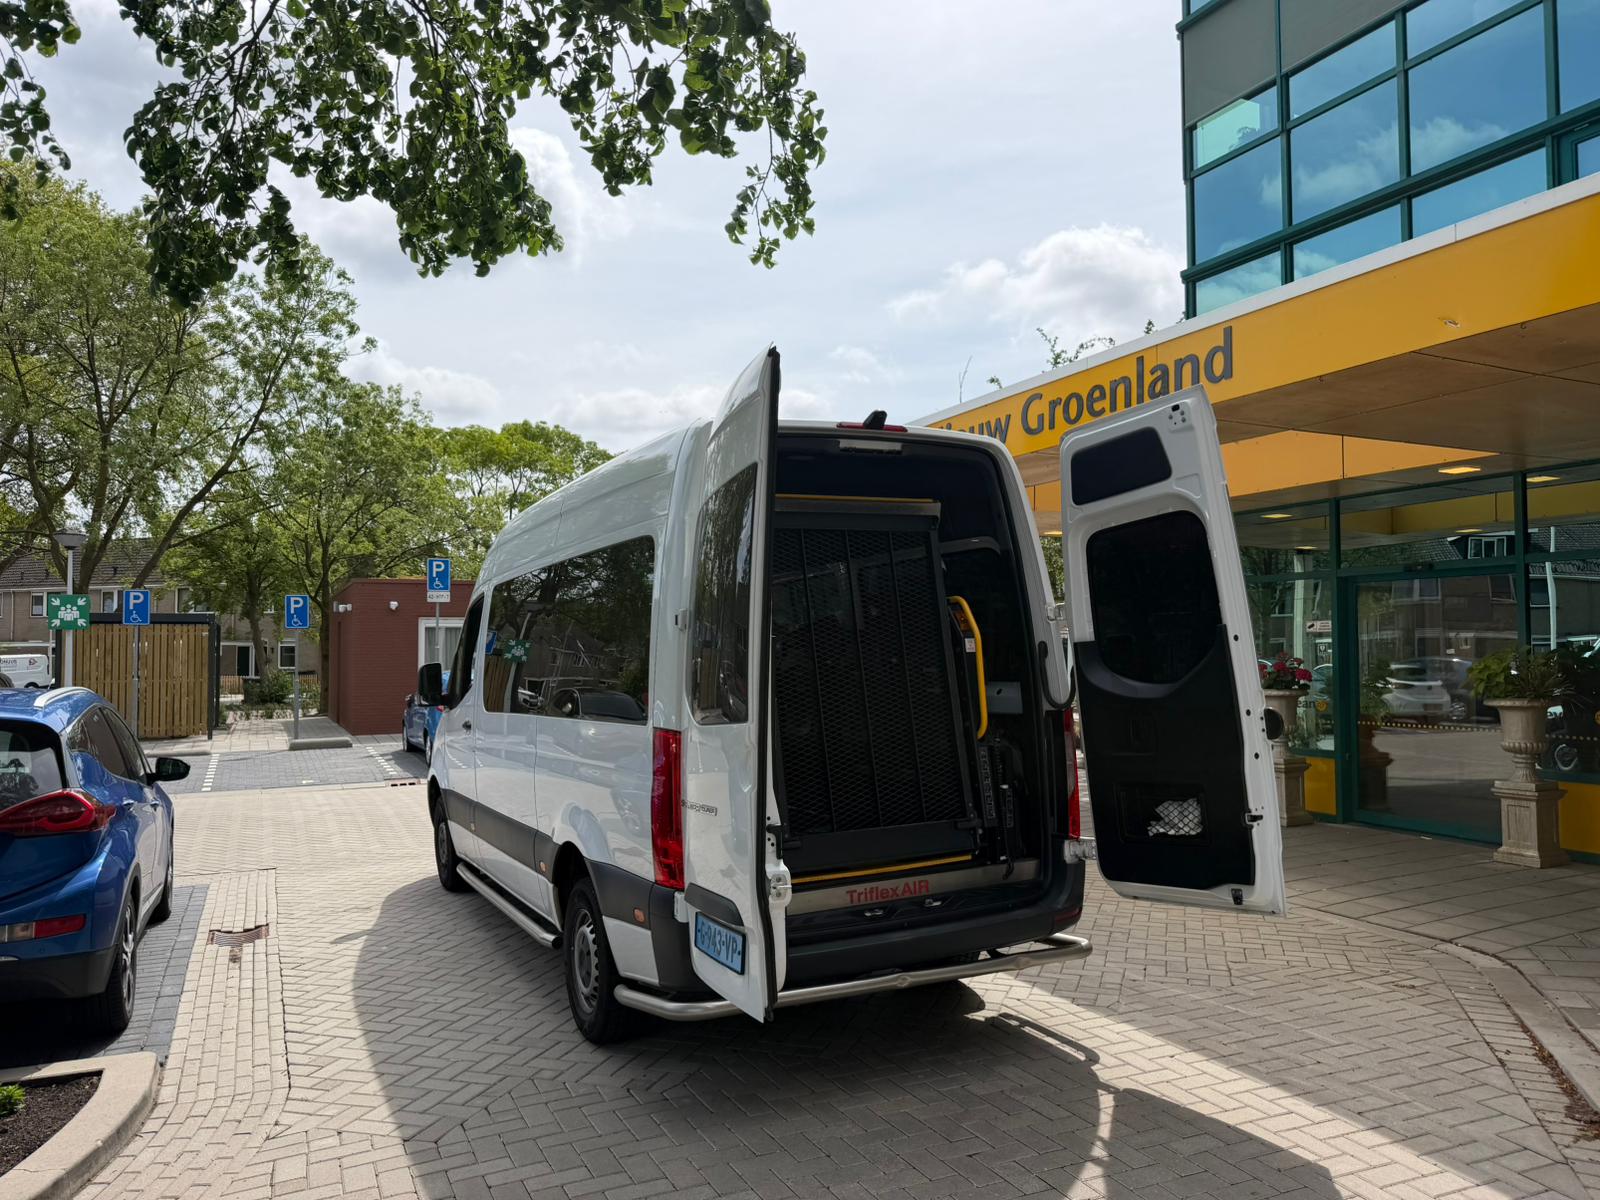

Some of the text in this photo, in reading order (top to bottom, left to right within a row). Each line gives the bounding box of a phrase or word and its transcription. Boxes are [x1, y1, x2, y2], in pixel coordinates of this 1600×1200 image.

[1021, 326, 1233, 435] Groenland
[433, 561, 445, 578] P
[129, 591, 144, 610] P
[290, 597, 304, 614] P
